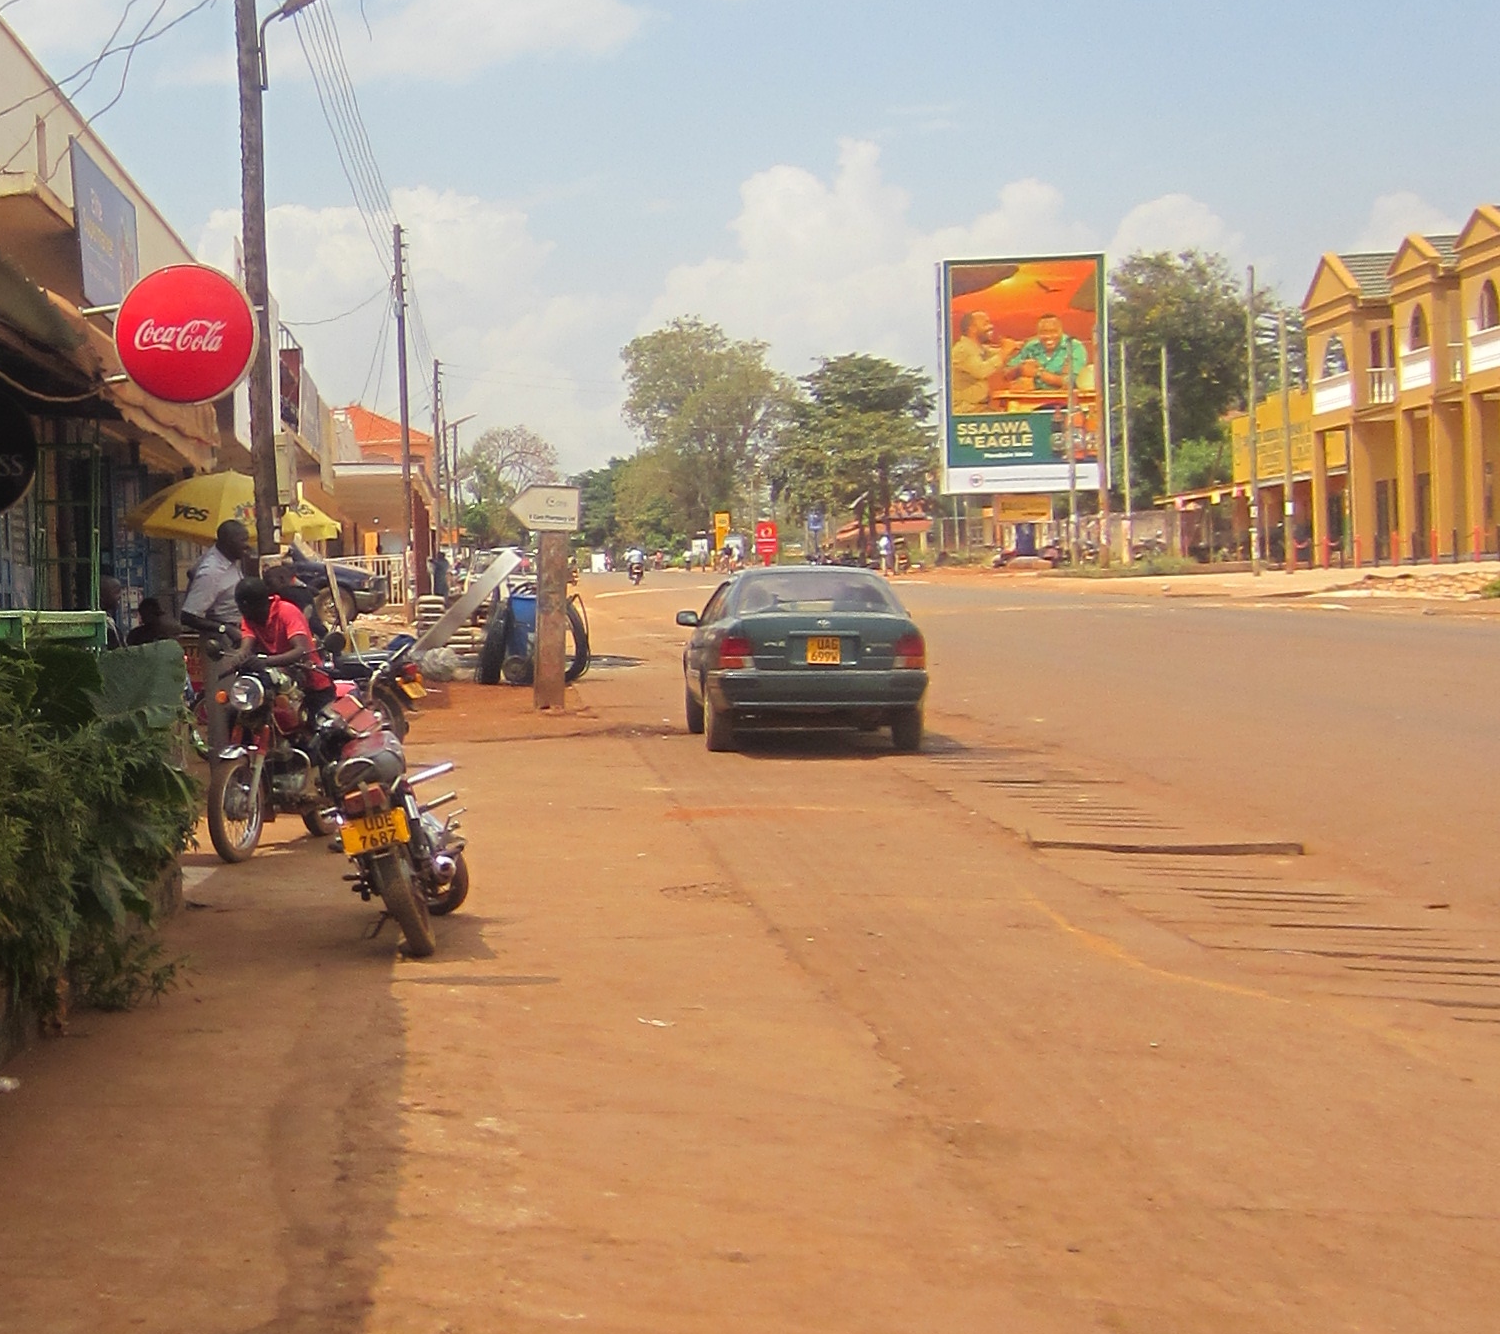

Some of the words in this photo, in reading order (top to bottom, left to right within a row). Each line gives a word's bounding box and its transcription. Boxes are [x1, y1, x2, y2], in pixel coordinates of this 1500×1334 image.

[134, 318, 227, 352] Coca-Cola
[957, 420, 1032, 435] SSAAWA
[958, 436, 973, 445] YA
[974, 433, 1034, 449] EAGLE
[172, 502, 210, 522] yes
[817, 637, 839, 650] UAG
[811, 651, 839, 662] 699W
